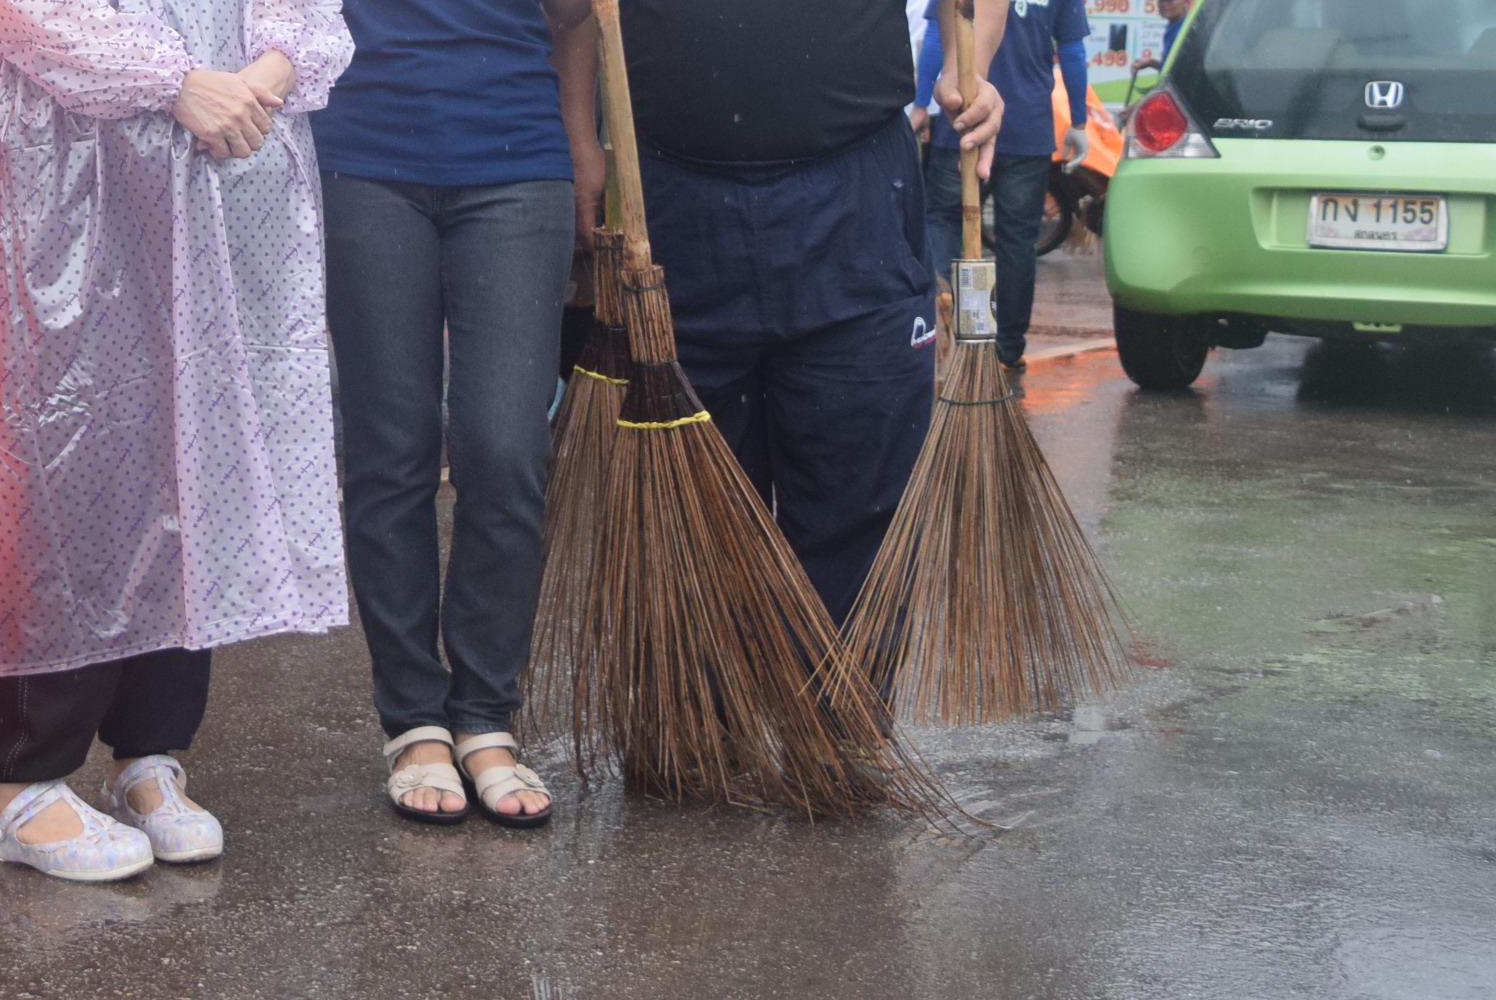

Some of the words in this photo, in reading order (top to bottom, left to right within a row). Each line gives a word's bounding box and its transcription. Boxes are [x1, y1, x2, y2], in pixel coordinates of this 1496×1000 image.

[1085, 49, 1128, 68] ,490
[1212, 118, 1274, 130] BRIO
[1373, 199, 1435, 226] 1155
